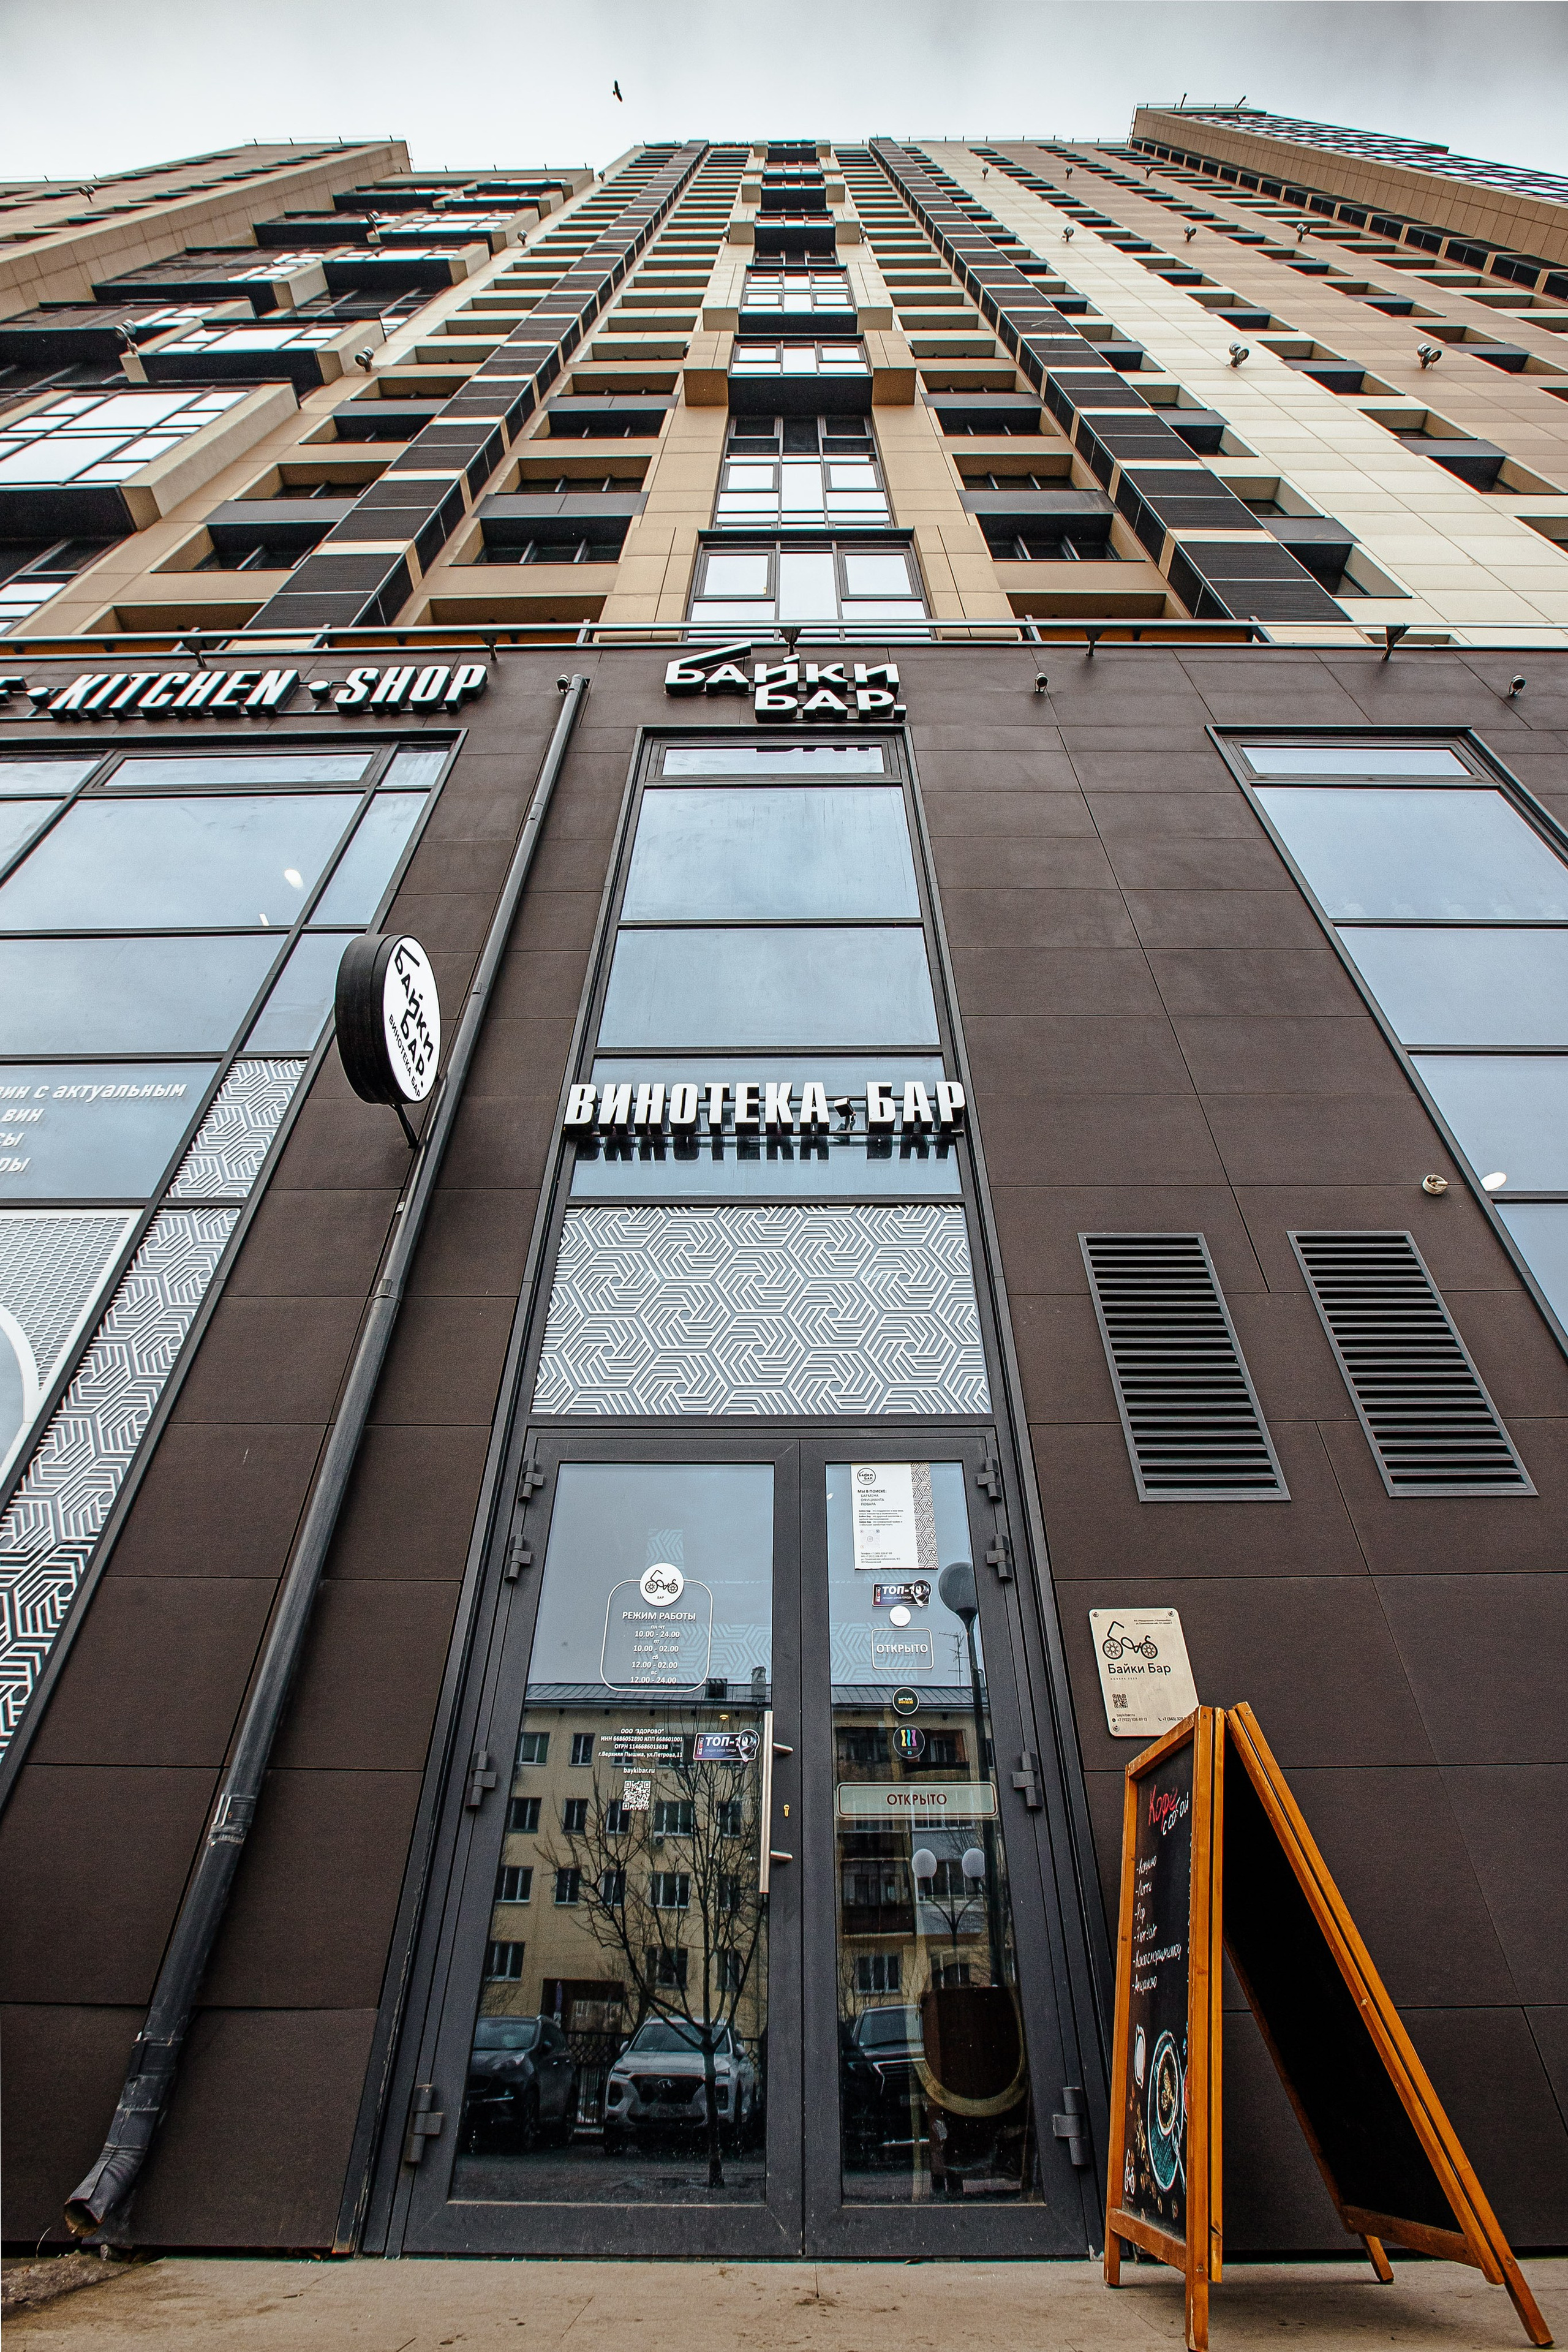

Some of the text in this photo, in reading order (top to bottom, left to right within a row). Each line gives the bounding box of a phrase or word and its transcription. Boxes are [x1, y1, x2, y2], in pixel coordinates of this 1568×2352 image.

[47, 668, 300, 714] KITCHEN
[333, 664, 488, 708] SHOP
[389, 1014, 421, 1098] ВИНОТЕКА БАР
[33, 1085, 50, 1099] с
[52, 1084, 188, 1103] актуальным
[564, 1081, 965, 1128] ВИНОТЕКА БАР
[1, 1108, 45, 1123] вин
[622, 1611, 696, 1621] РЕЖИМ РАБОТЫ
[876, 1643, 929, 1654] ОТКРЫТО
[1107, 1662, 1171, 1676] Байки Бар
[886, 1793, 948, 1806] ОТКРЫТО
